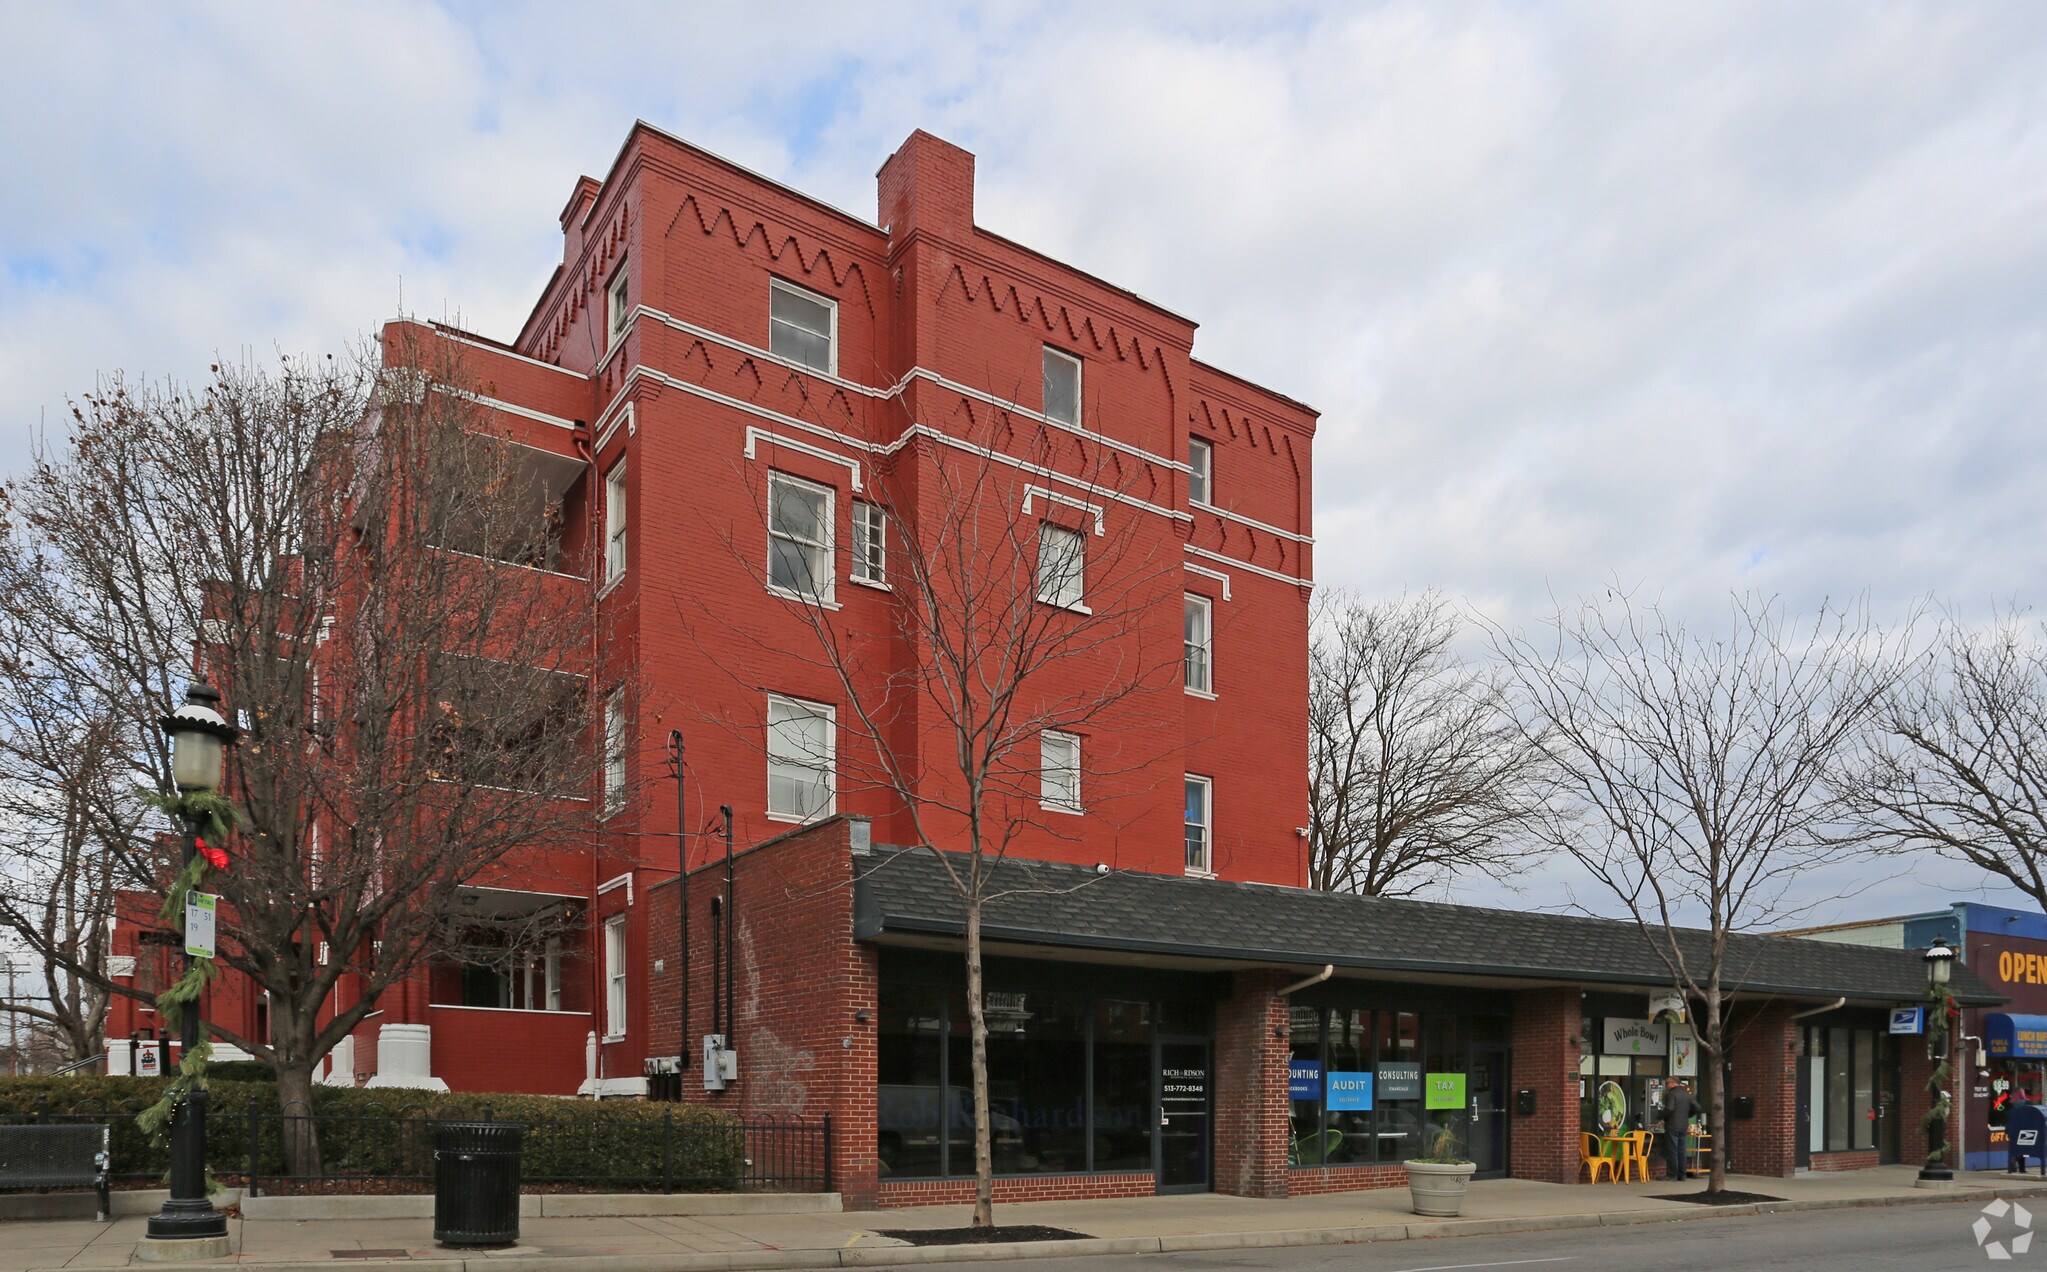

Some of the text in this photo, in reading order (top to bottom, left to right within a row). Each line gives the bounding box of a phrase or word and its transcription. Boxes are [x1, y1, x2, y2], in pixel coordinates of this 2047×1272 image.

[191, 909, 198, 917] 17
[190, 923, 198, 931] 19
[1614, 1026, 1658, 1043] Whole Bowl
[1378, 1070, 1418, 1080] CONSULTING
[1332, 1080, 1366, 1091] AUDIT
[1436, 1081, 1454, 1091] TAX
[1990, 1132, 2005, 1142] GIFT
